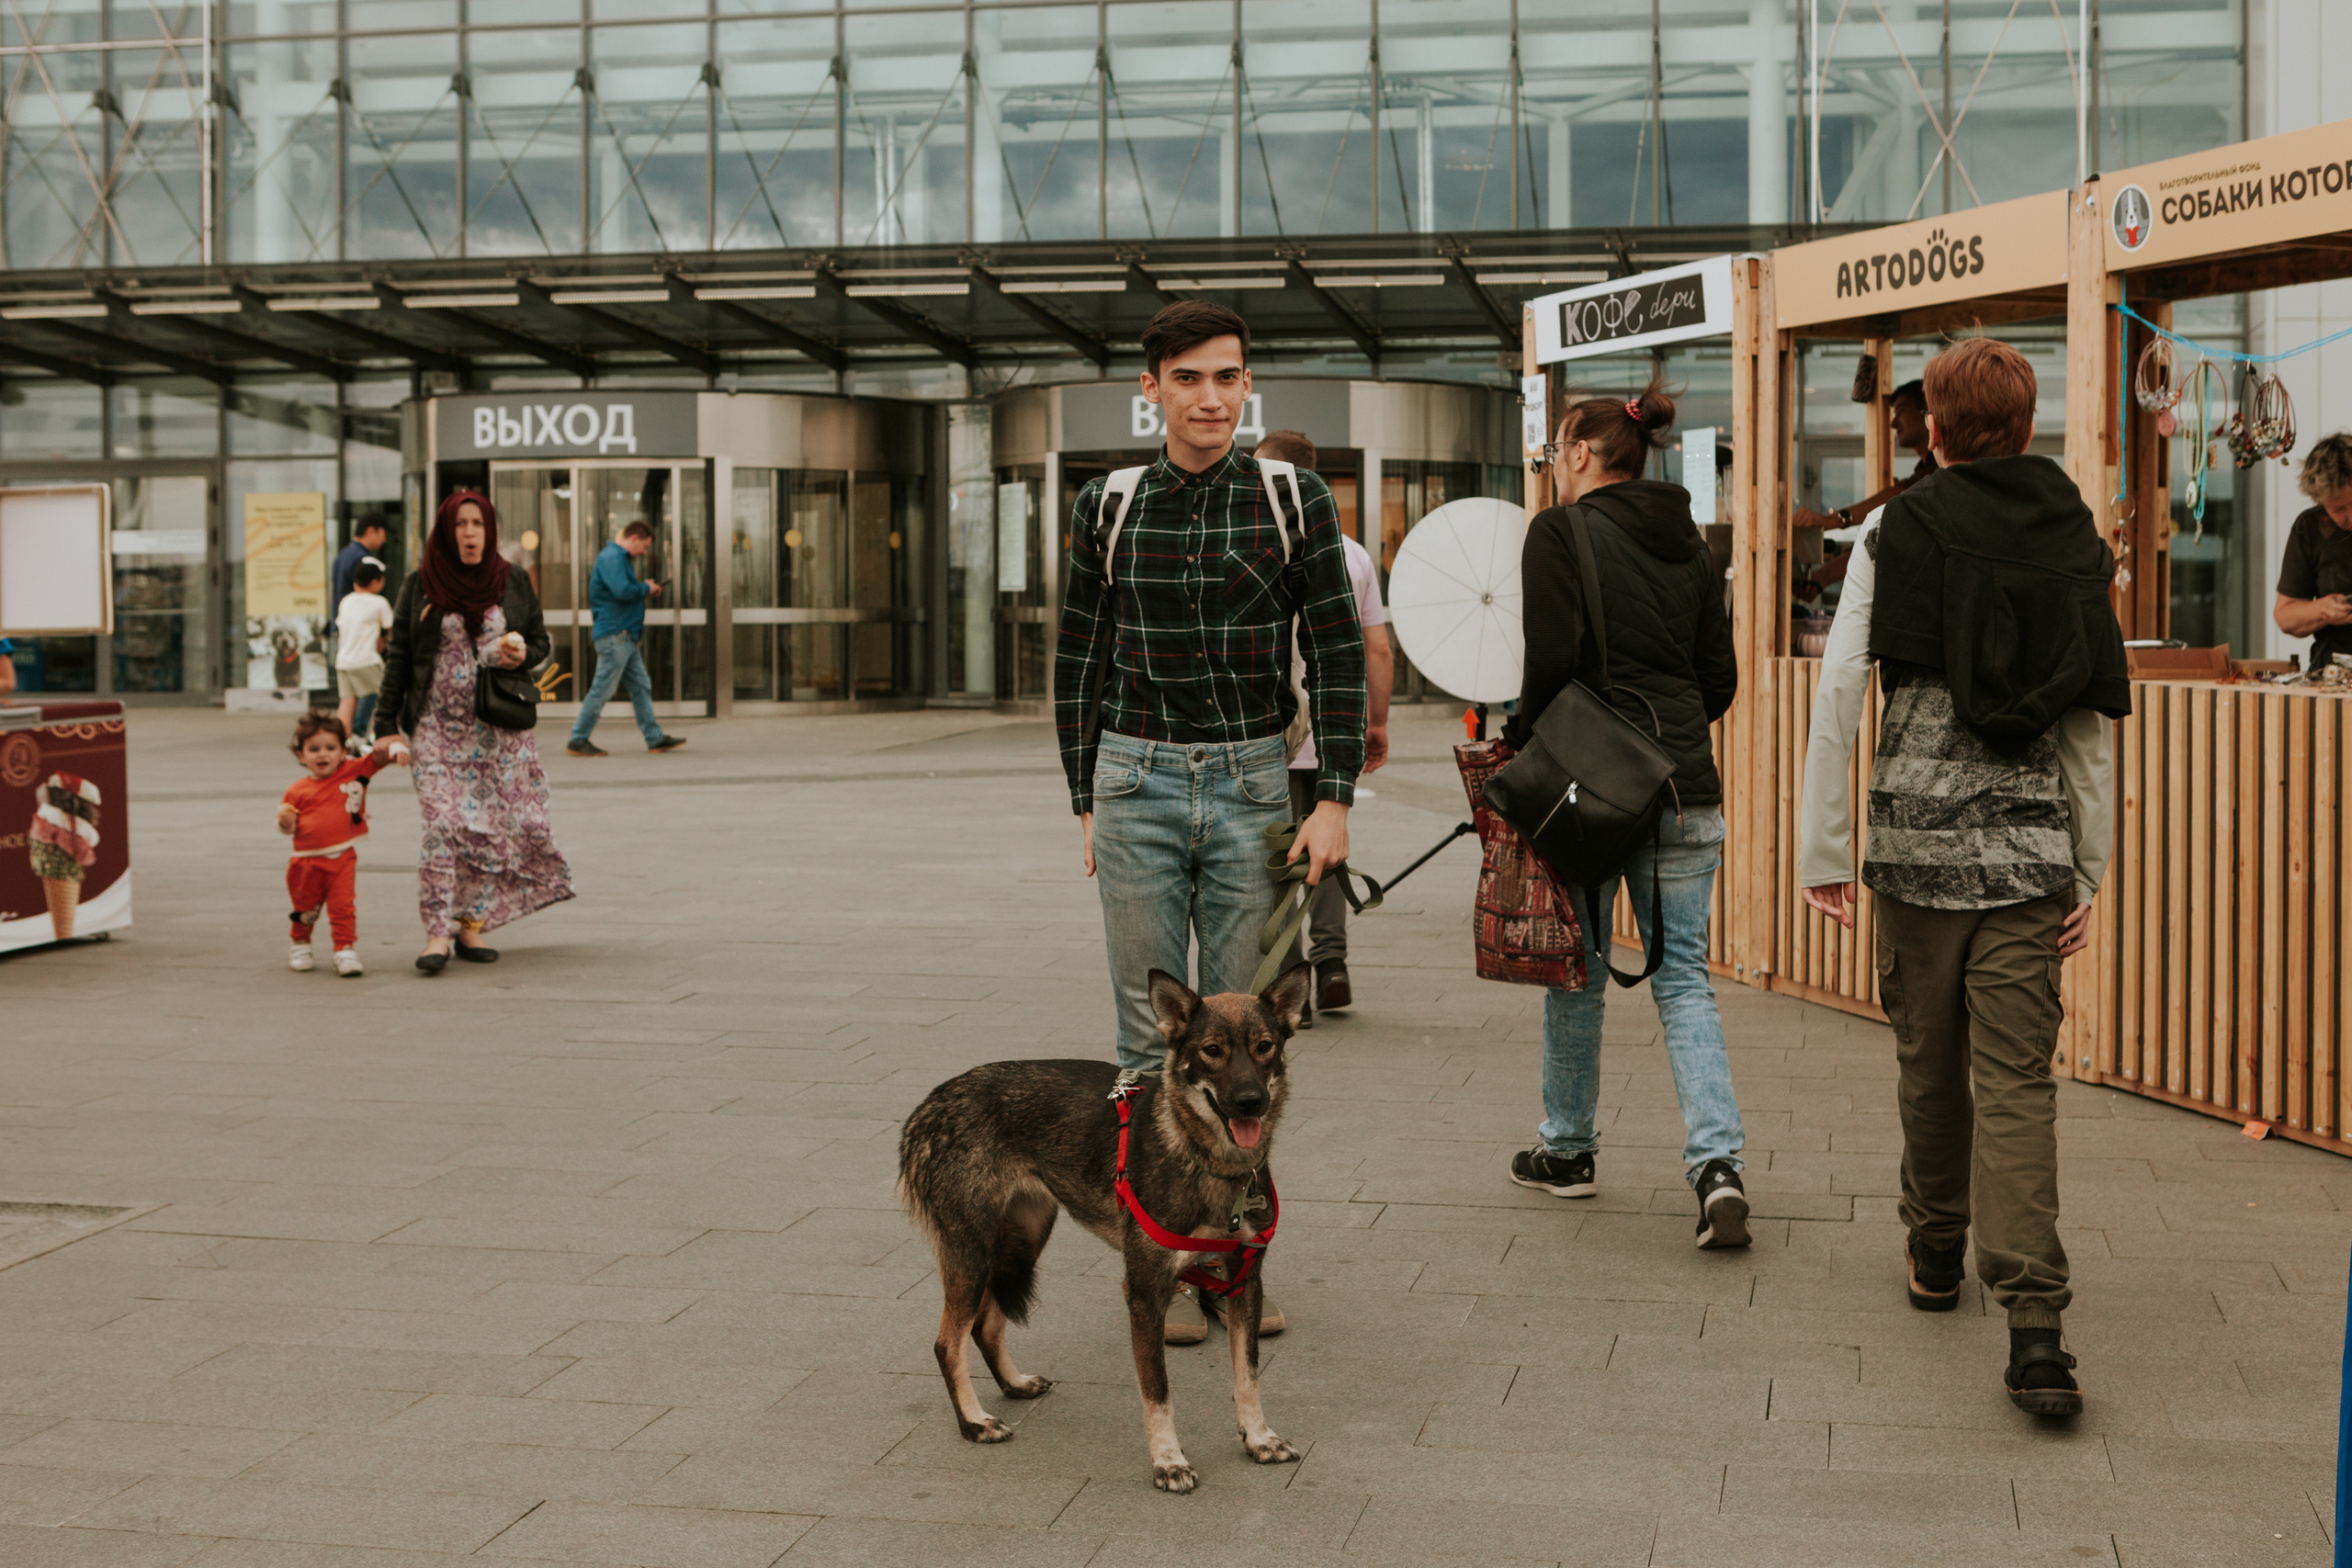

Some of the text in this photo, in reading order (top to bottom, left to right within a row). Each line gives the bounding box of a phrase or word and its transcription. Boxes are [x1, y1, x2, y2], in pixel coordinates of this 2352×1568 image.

[2159, 161, 2262, 190] БЛАГОТВОРИТЕЛЬНЫЙ ФОНД
[2161, 177, 2264, 225] СОБАКИ
[473, 402, 638, 456] ВЫХОД
[1131, 392, 1266, 443] ВД
